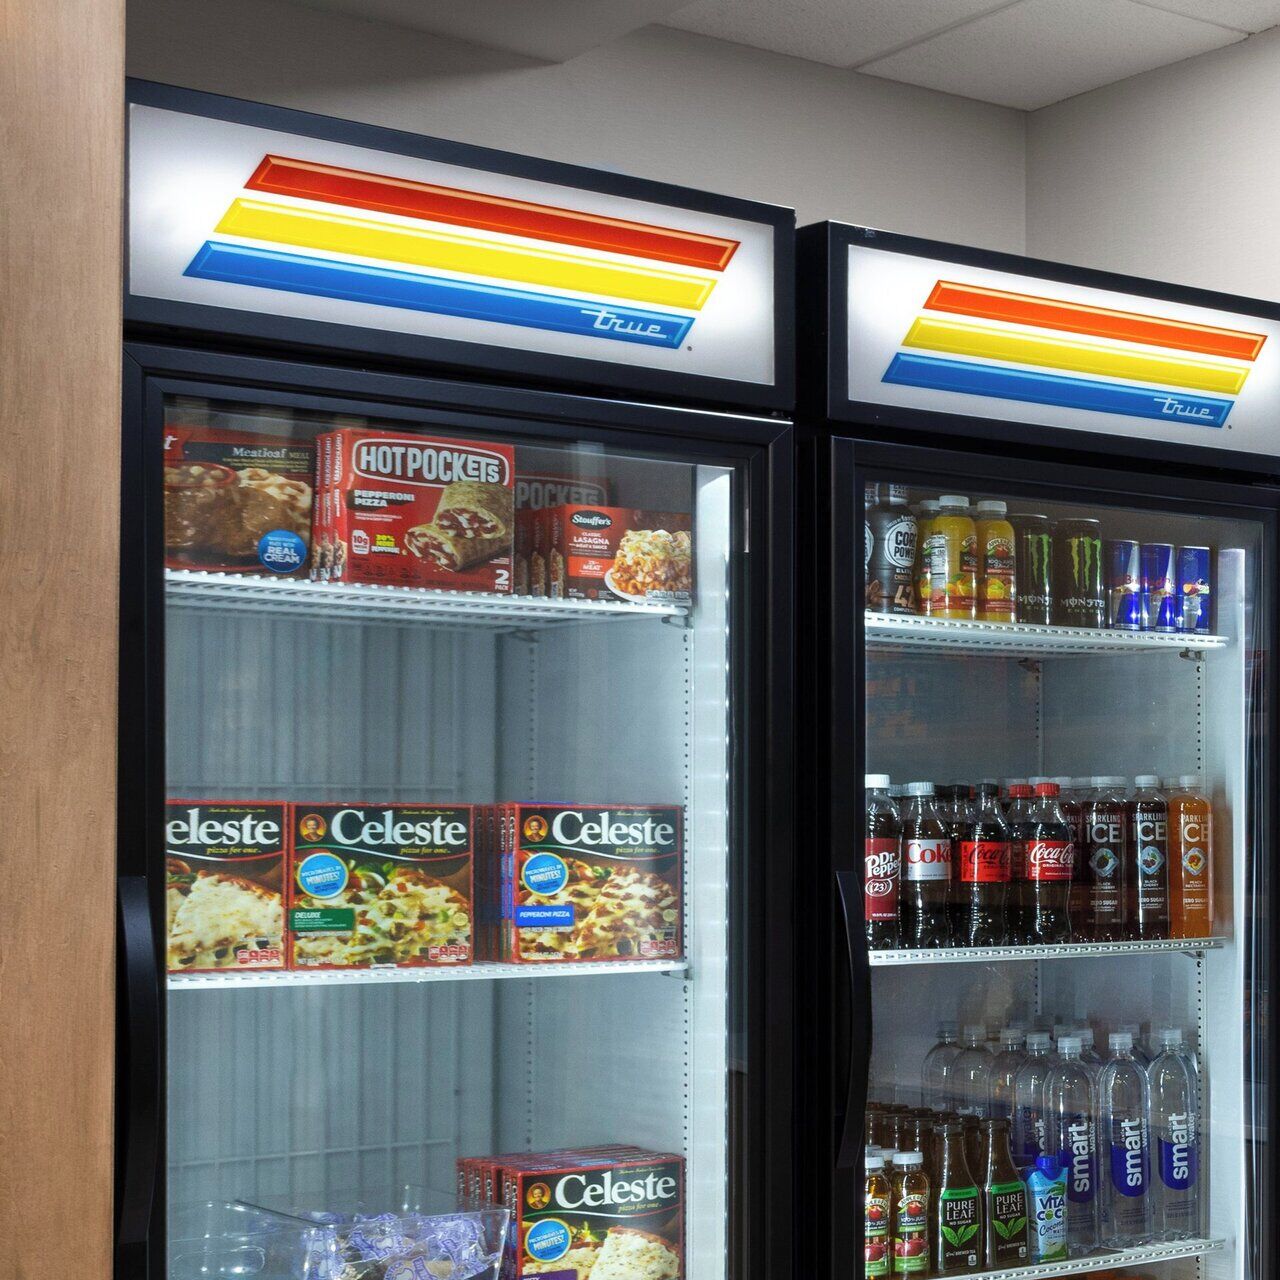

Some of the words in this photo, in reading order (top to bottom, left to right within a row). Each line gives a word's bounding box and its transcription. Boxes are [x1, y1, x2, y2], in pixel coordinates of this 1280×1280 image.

[580, 309, 668, 340] true
[1153, 397, 1214, 420] true
[232, 447, 287, 458] Meatloaf
[360, 446, 406, 476] HOT
[407, 448, 500, 483] POCKETS
[354, 490, 415, 502] PEPPERONI
[354, 499, 388, 507] PIZZA
[571, 514, 612, 526] Stouffer's
[573, 536, 610, 545] LASAGNA
[267, 546, 295, 556] REAL
[264, 553, 300, 564] CREAM
[496, 570, 510, 584] 2
[166, 808, 280, 846] eleste
[331, 809, 467, 846] Celeste
[552, 811, 675, 846] Celeste
[1086, 824, 1121, 843] ICE
[1133, 822, 1167, 842] ICE
[879, 851, 895, 866] Dr
[873, 883, 885, 892] 23
[1121, 1117, 1142, 1187] smart
[1168, 1112, 1189, 1180] smart
[1068, 1122, 1090, 1192] smart
[555, 1172, 676, 1209] Celeste
[946, 1200, 975, 1211] PURE
[996, 1193, 1023, 1206] PURE
[1039, 1196, 1065, 1209] VITA
[618, 1204, 635, 1213] pizza
[946, 1209, 975, 1220] LEAF
[996, 1203, 1024, 1215] LEAF
